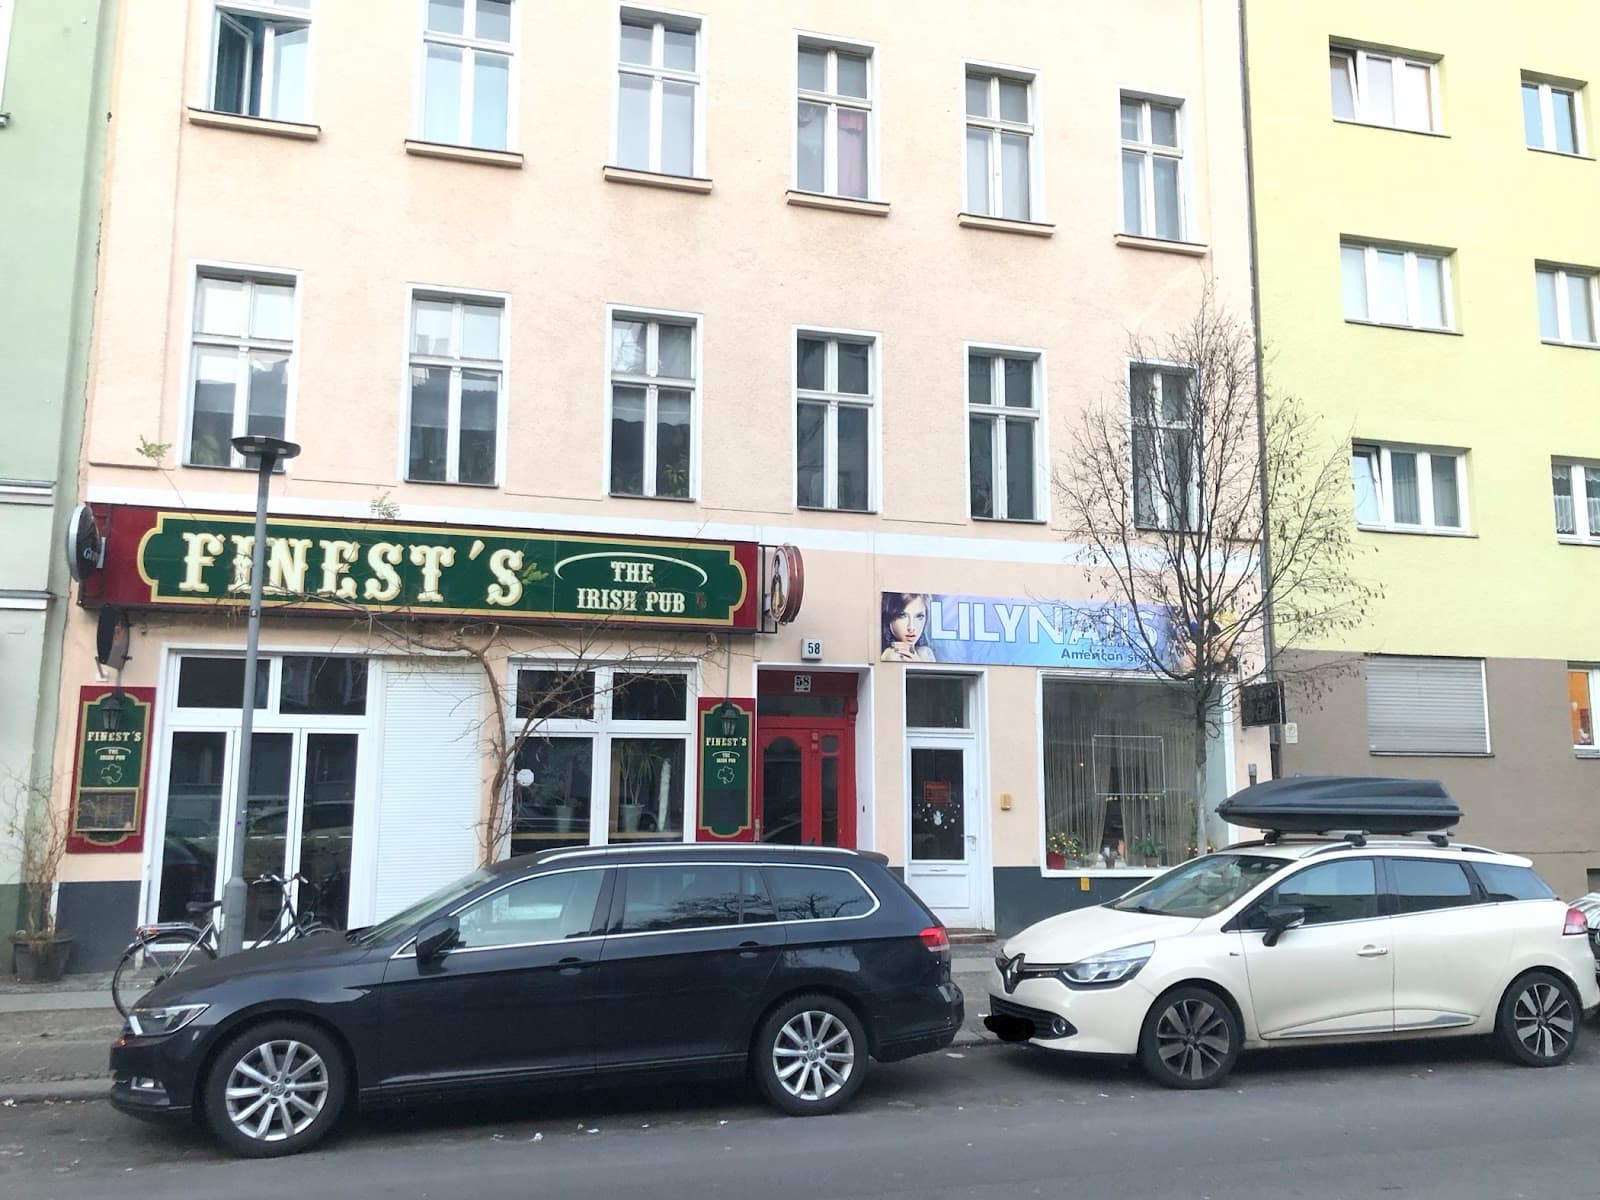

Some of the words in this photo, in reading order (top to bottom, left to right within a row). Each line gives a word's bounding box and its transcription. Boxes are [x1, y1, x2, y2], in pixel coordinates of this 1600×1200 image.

[611, 561, 654, 583] THE
[577, 588, 638, 612] IRISH
[645, 591, 685, 613] PUB
[808, 642, 821, 655] 58
[1061, 648, 1123, 662] American
[796, 676, 809, 687] 58
